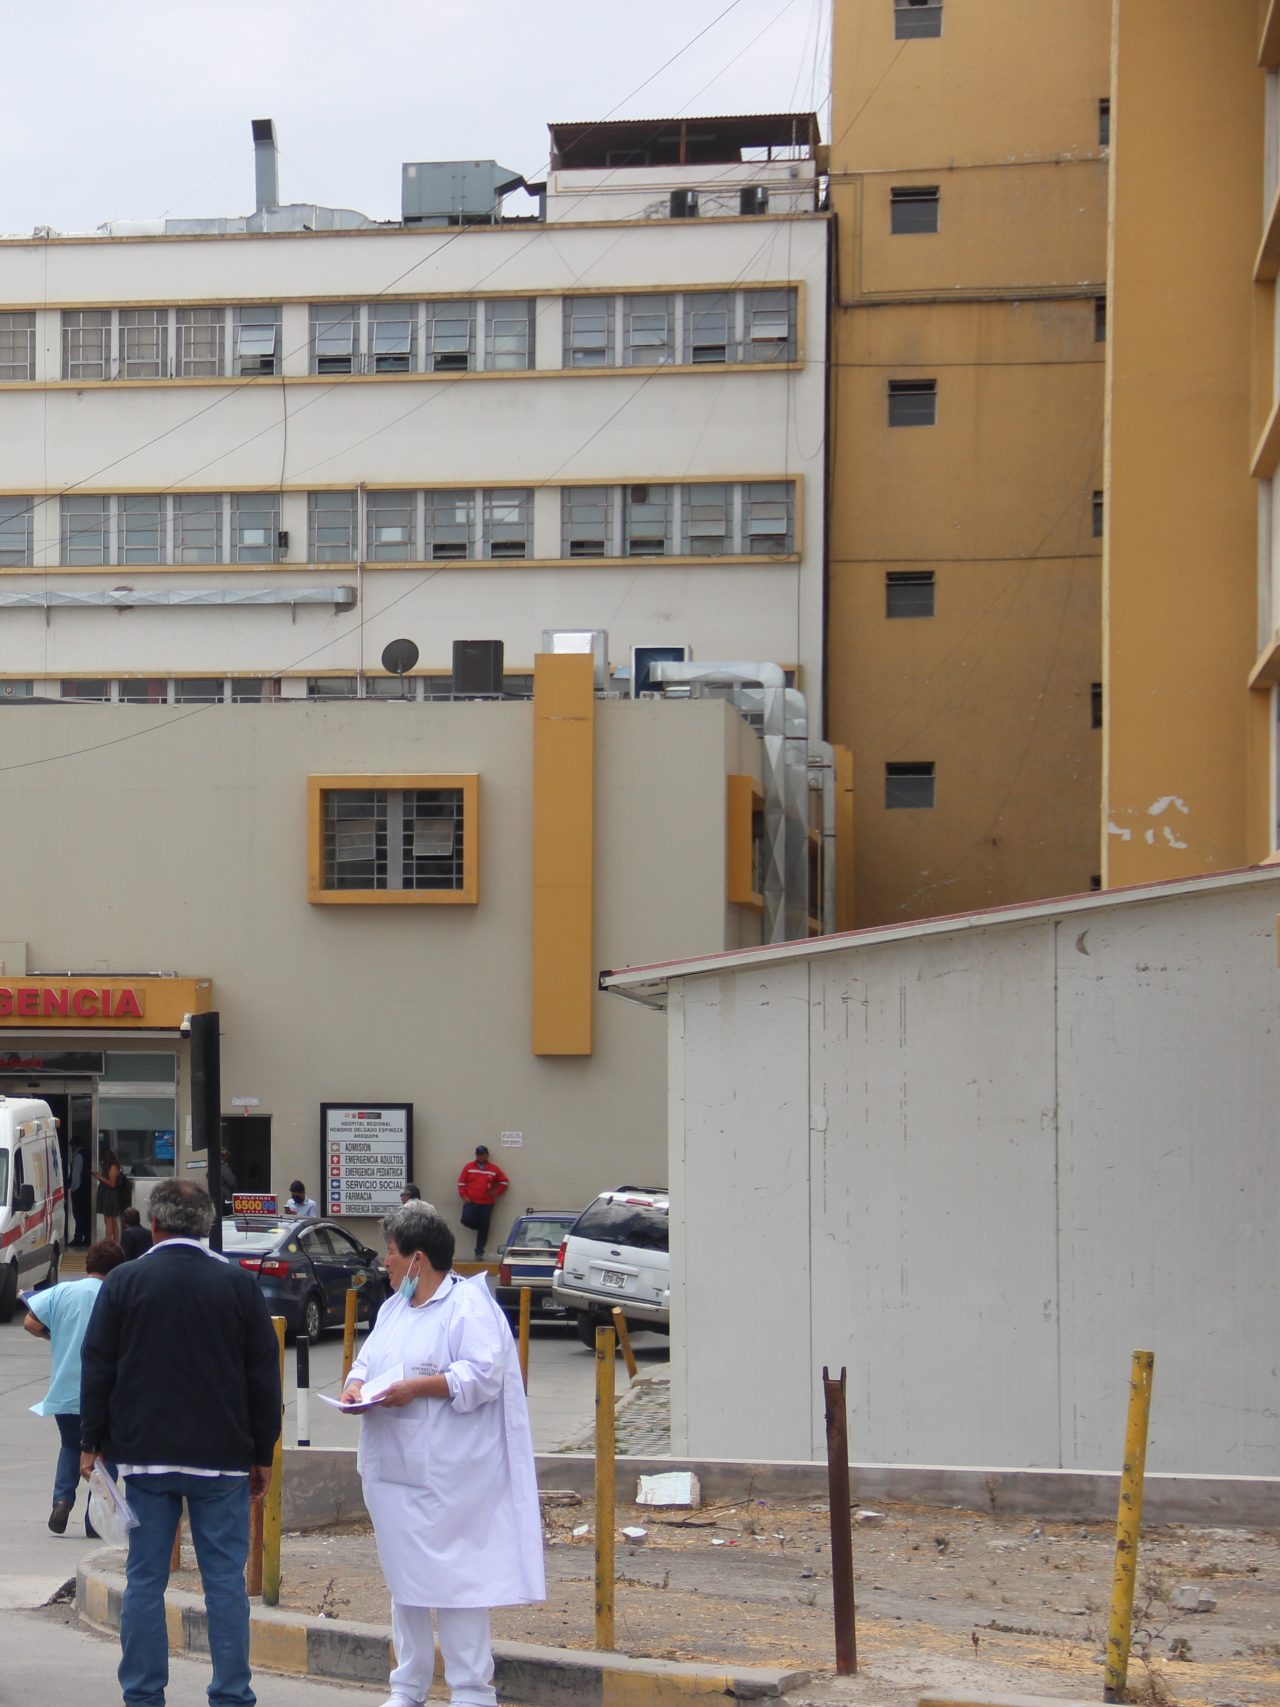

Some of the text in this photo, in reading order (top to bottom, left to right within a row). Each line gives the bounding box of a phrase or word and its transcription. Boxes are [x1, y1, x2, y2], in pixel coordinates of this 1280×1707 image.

[345, 1143, 371, 1152] ADMISION
[345, 1155, 404, 1165] EMERGENCIA ADULTOS
[345, 1168, 403, 1177] EMERGENCIA PEDIATRICA
[345, 1180, 403, 1189] SERVICIO SOCIAL
[345, 1192, 372, 1201] FARMACIA
